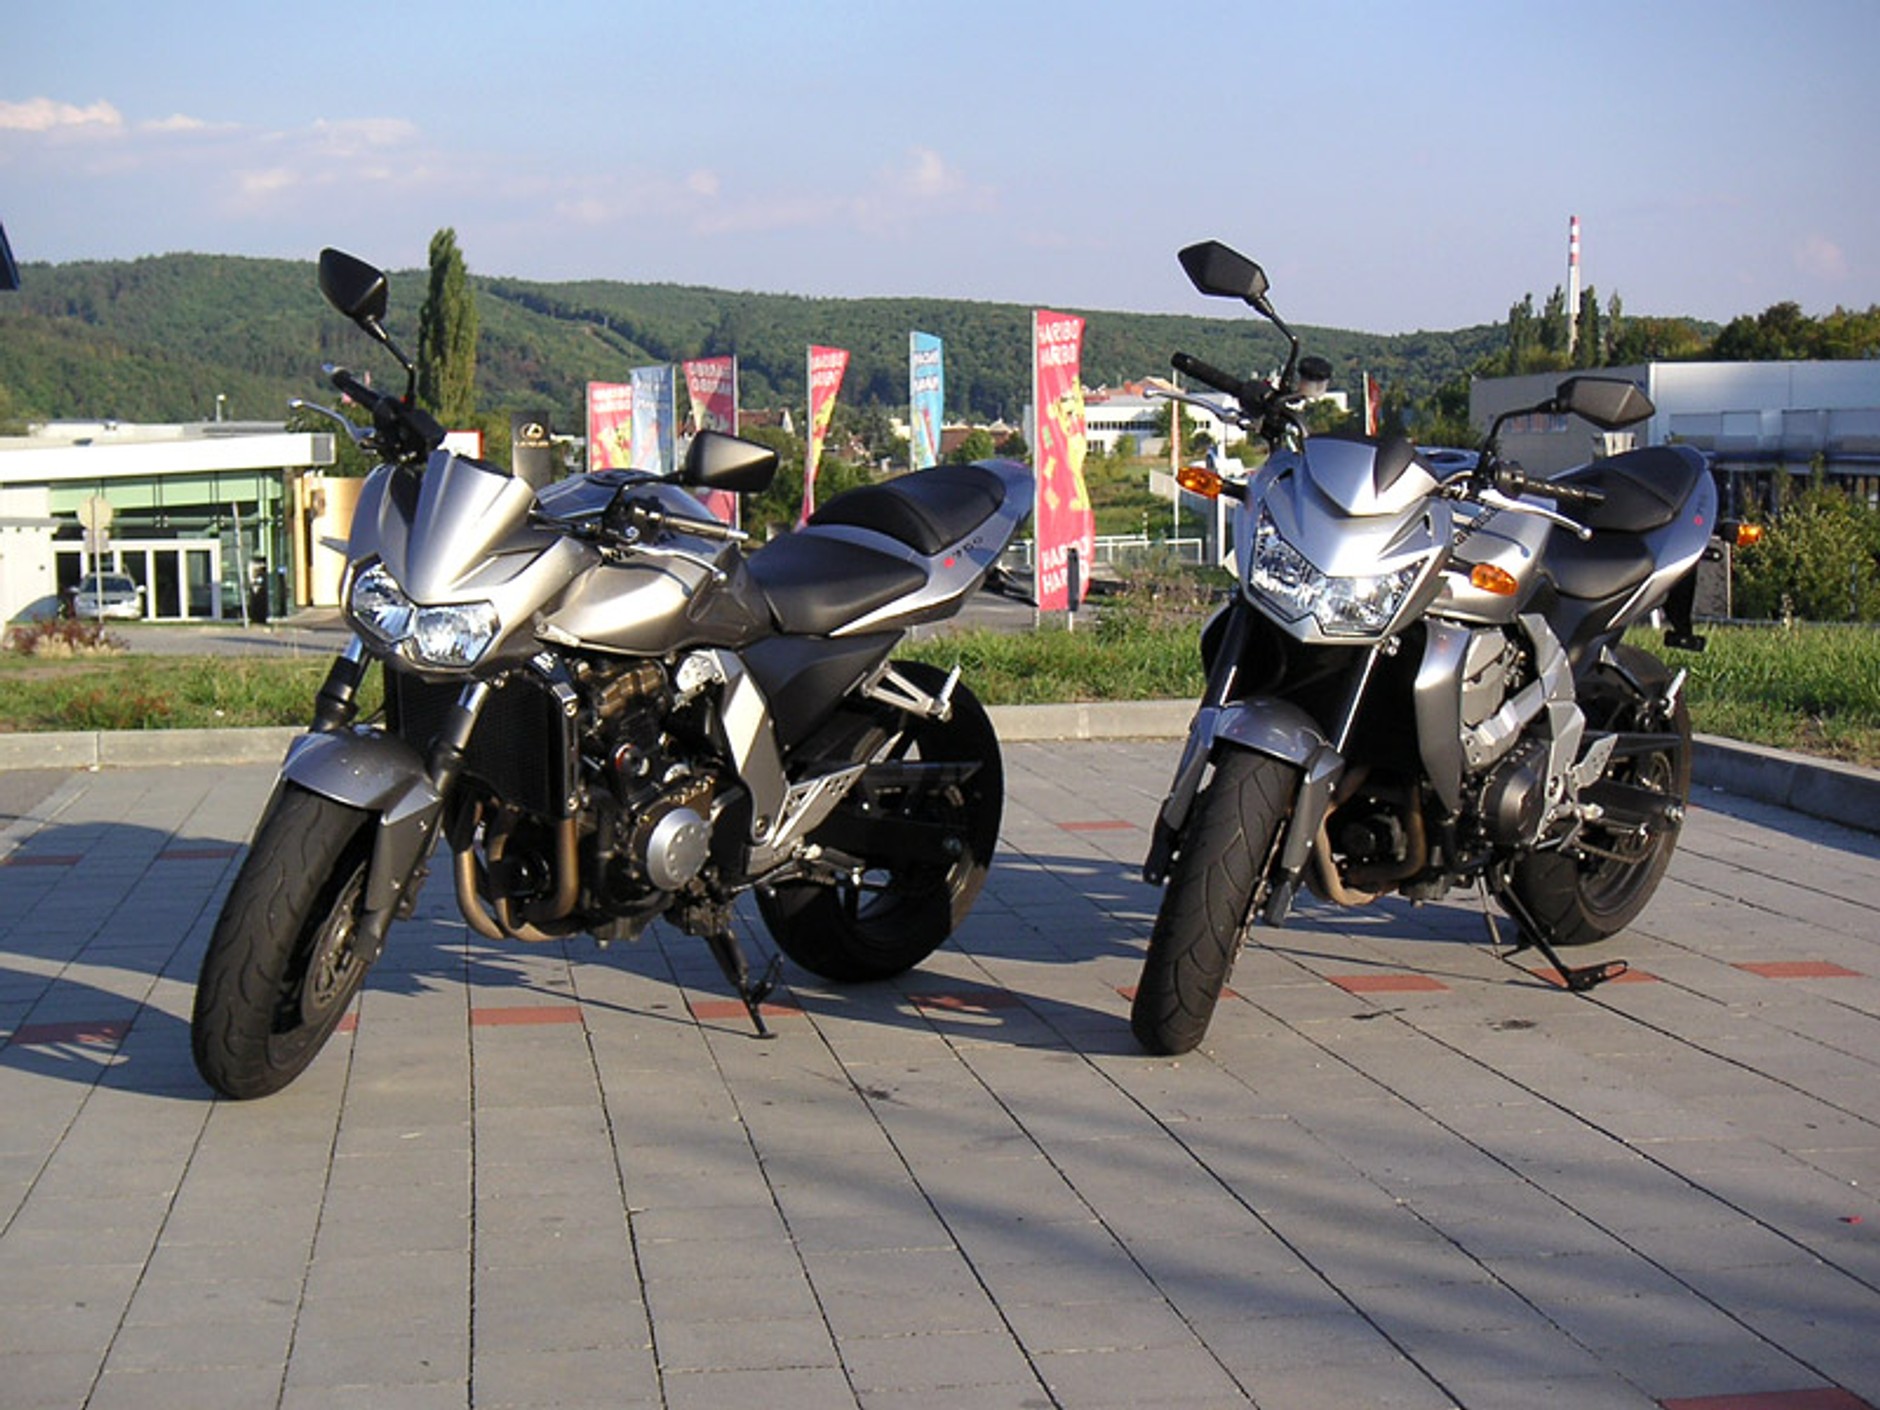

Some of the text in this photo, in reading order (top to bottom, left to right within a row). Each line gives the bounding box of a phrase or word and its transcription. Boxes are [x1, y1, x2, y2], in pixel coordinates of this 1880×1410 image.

[1037, 319, 1080, 345] HARIBO
[1042, 536, 1090, 571] HARO
[1042, 559, 1089, 596] HARO
